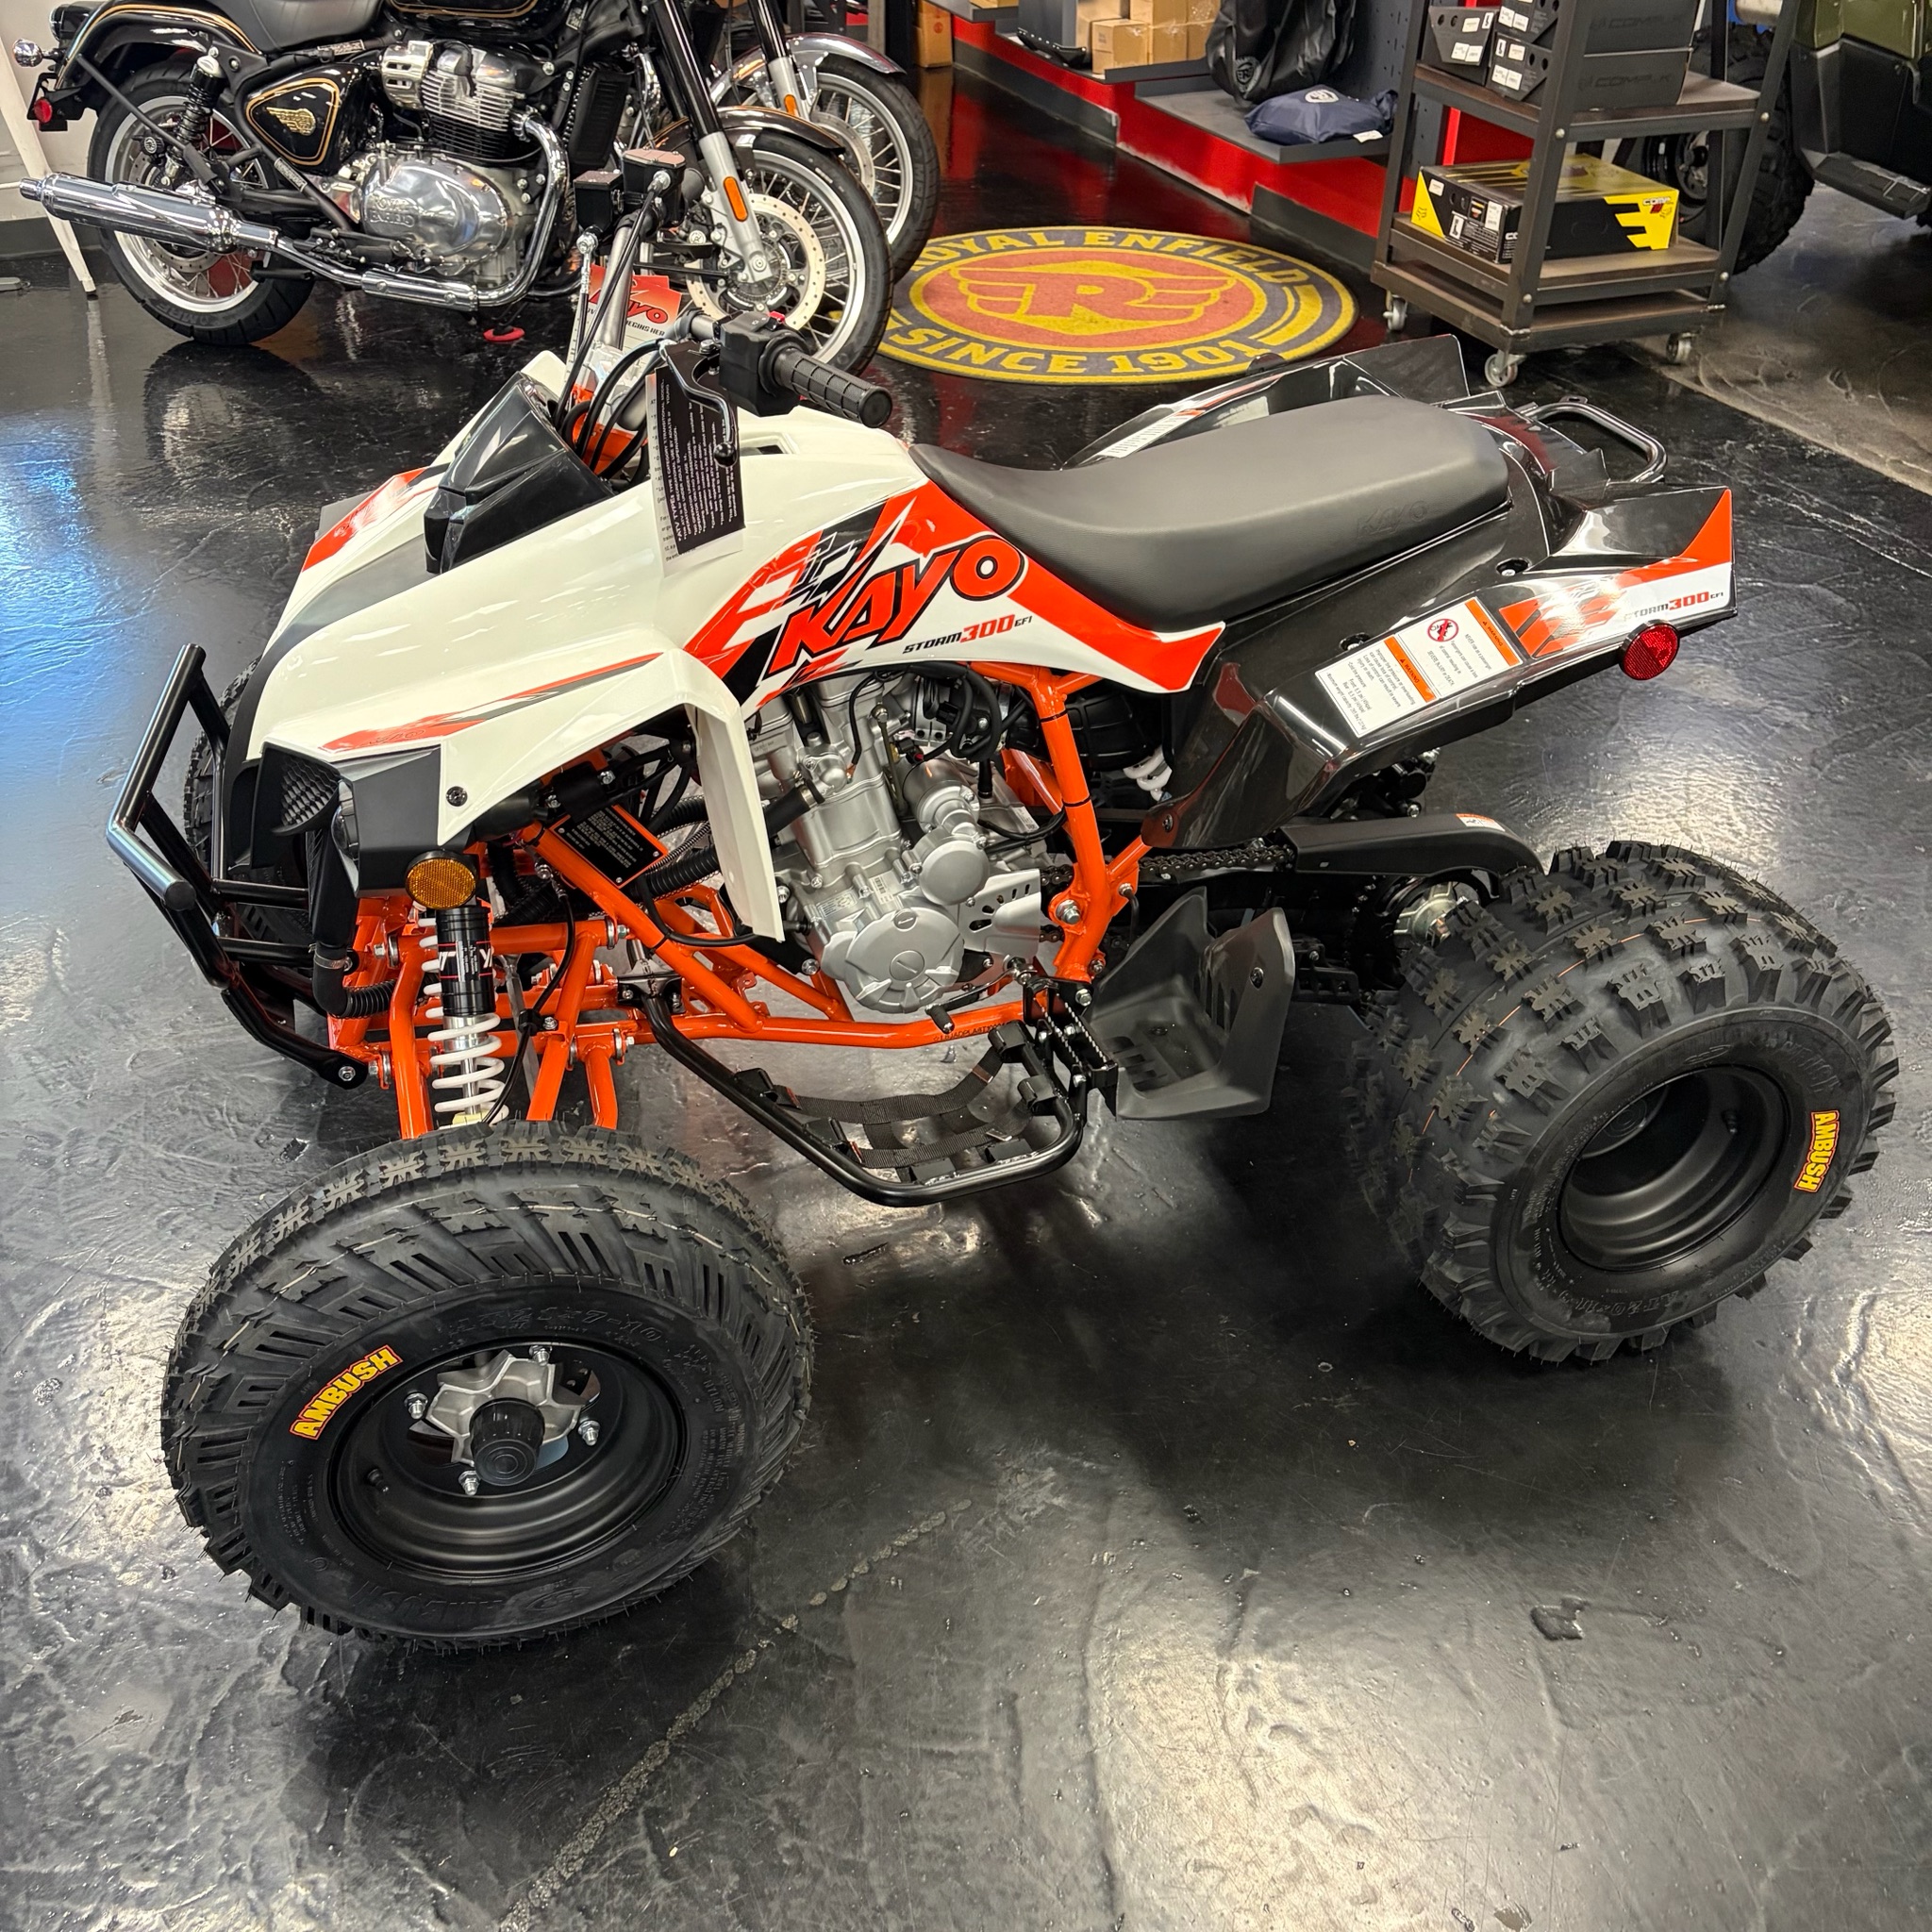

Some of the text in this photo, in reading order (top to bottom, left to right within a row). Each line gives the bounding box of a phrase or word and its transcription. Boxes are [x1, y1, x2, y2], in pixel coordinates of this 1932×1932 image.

[1084, 231, 1310, 283] ENFIELD
[889, 327, 1272, 374] SINCE 1901
[764, 534, 1025, 678] KAYO
[1486, 625, 1503, 646] WARNING
[1403, 663, 1420, 683] WARNING
[1794, 1110, 1840, 1192] AMBUSH
[290, 1344, 403, 1441] AMBUSH
